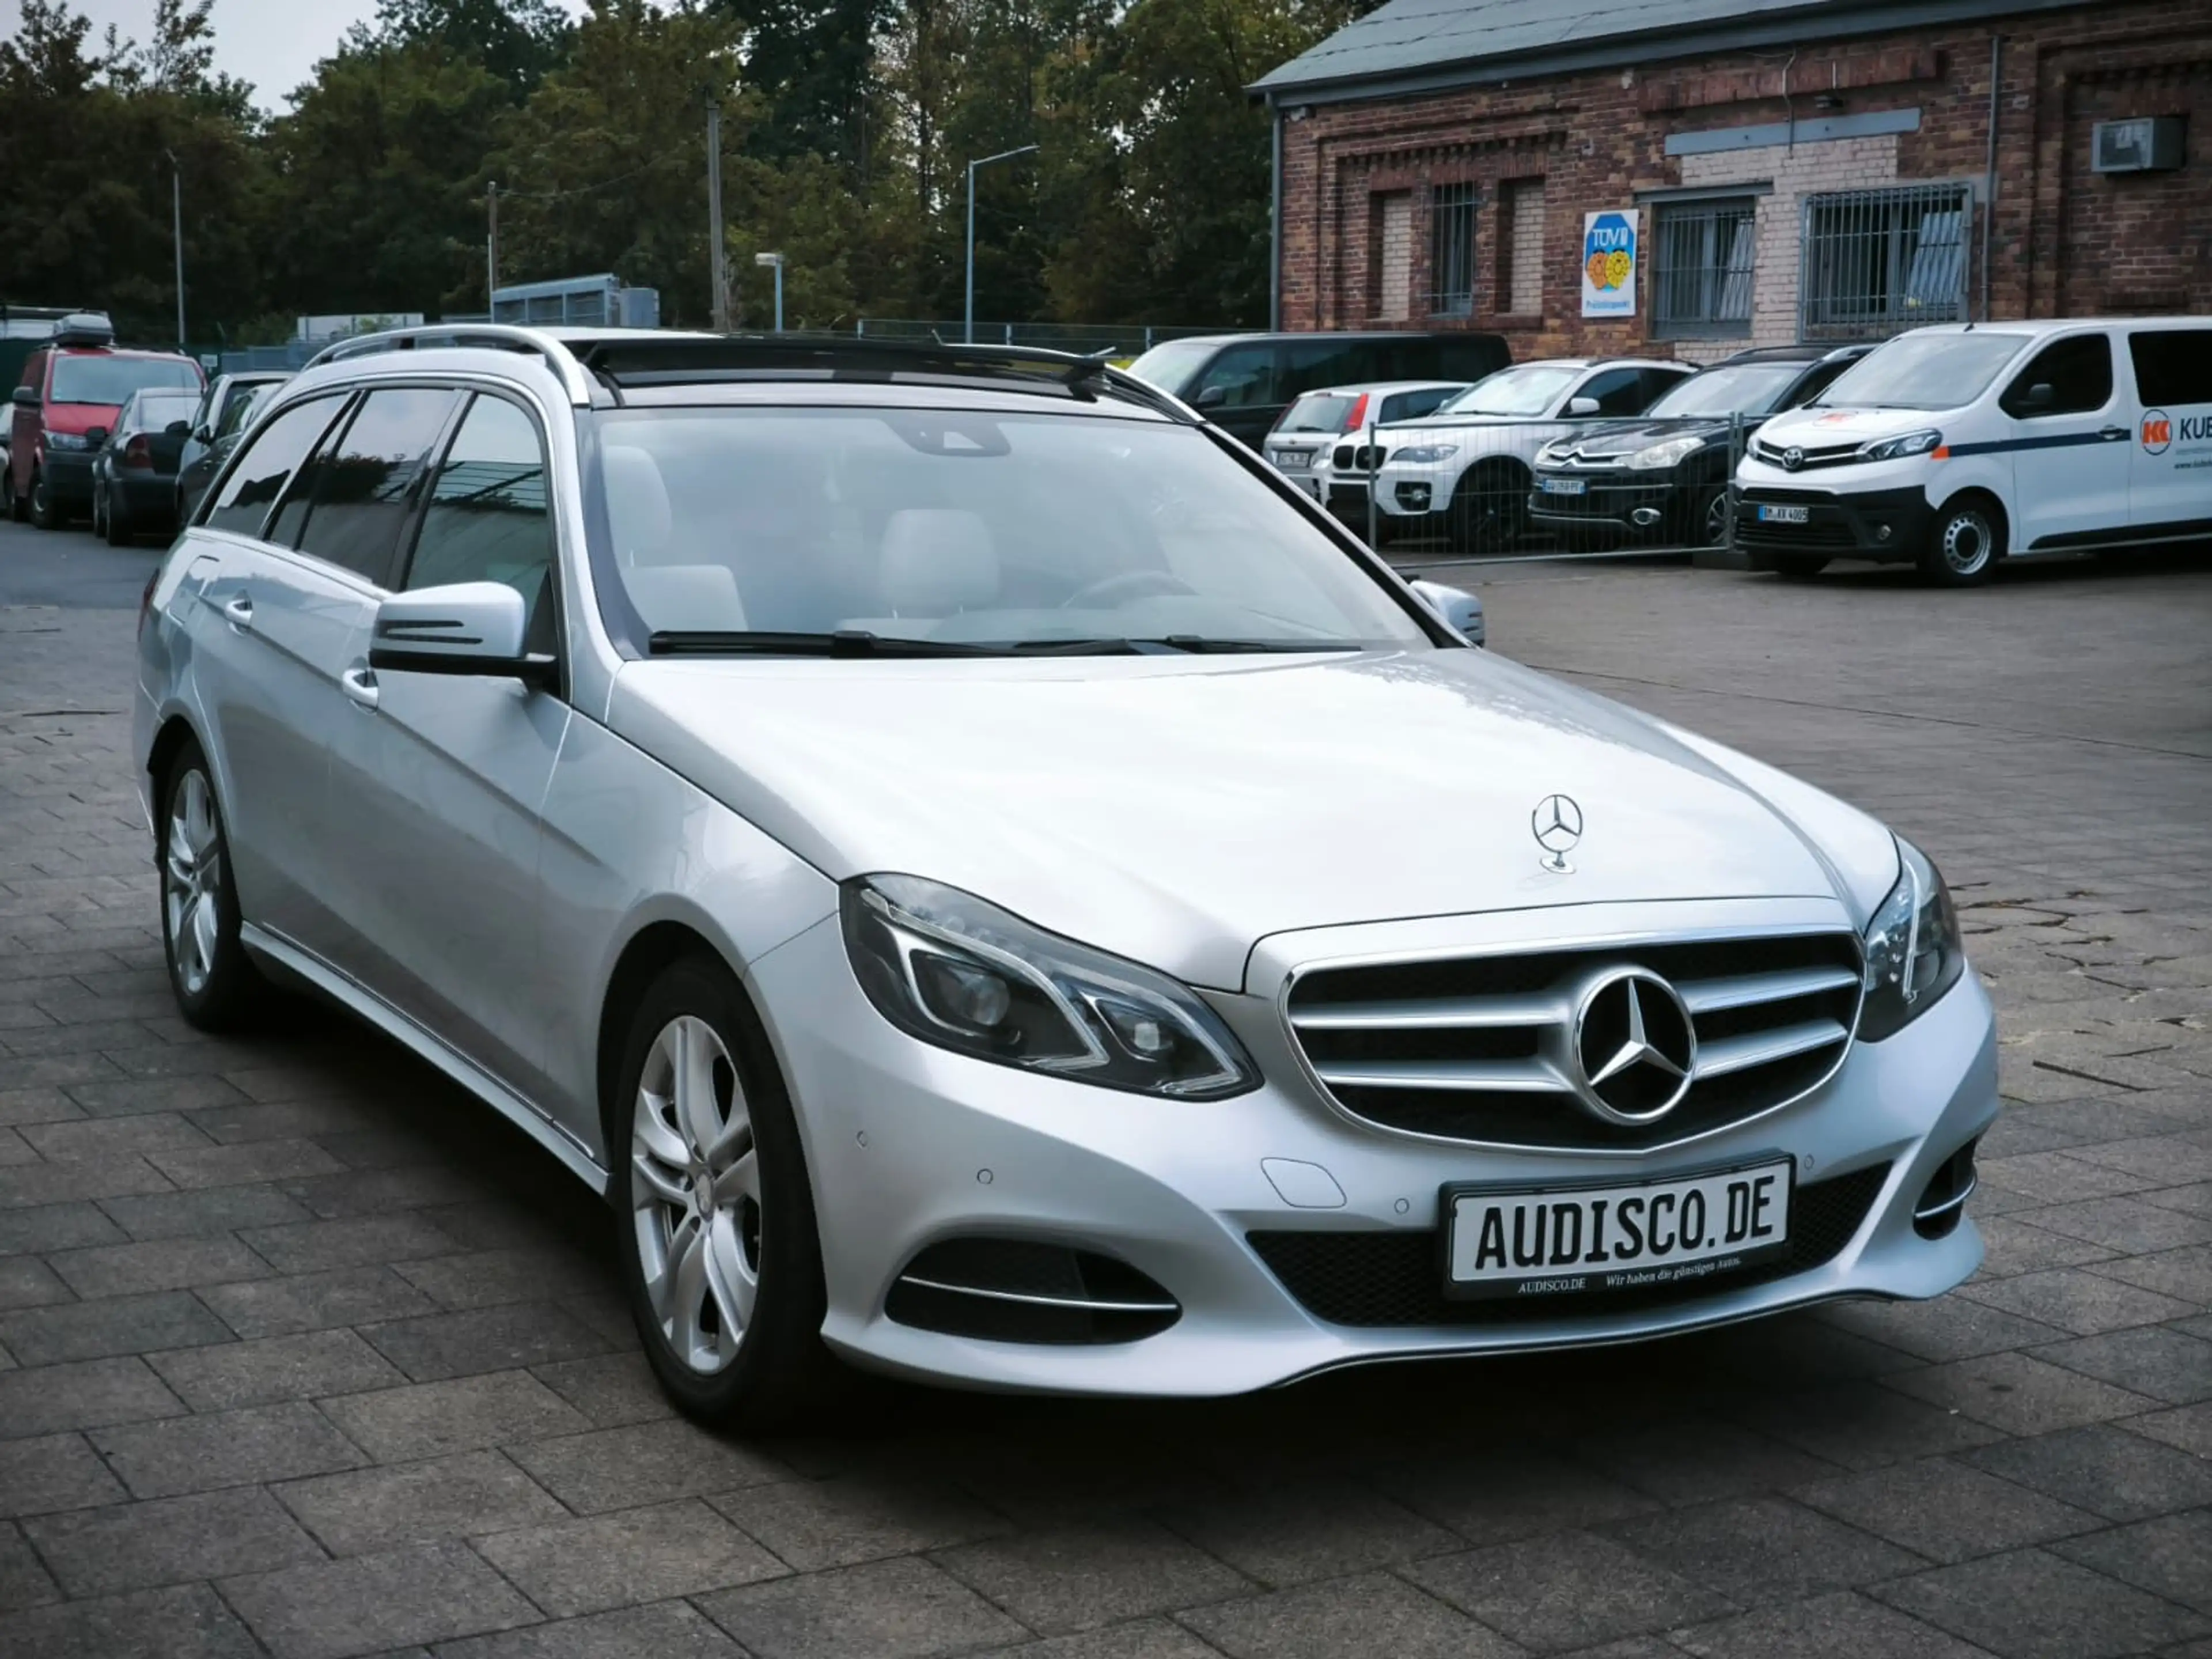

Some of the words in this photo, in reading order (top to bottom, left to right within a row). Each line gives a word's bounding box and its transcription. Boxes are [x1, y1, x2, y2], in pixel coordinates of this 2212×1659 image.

[1475, 1175, 1775, 1270] AUDISCO.DE
[1518, 1277, 1586, 1293] AUDISCO.DE
[1607, 1274, 1626, 1286] Wir
[1627, 1271, 1656, 1284] haben
